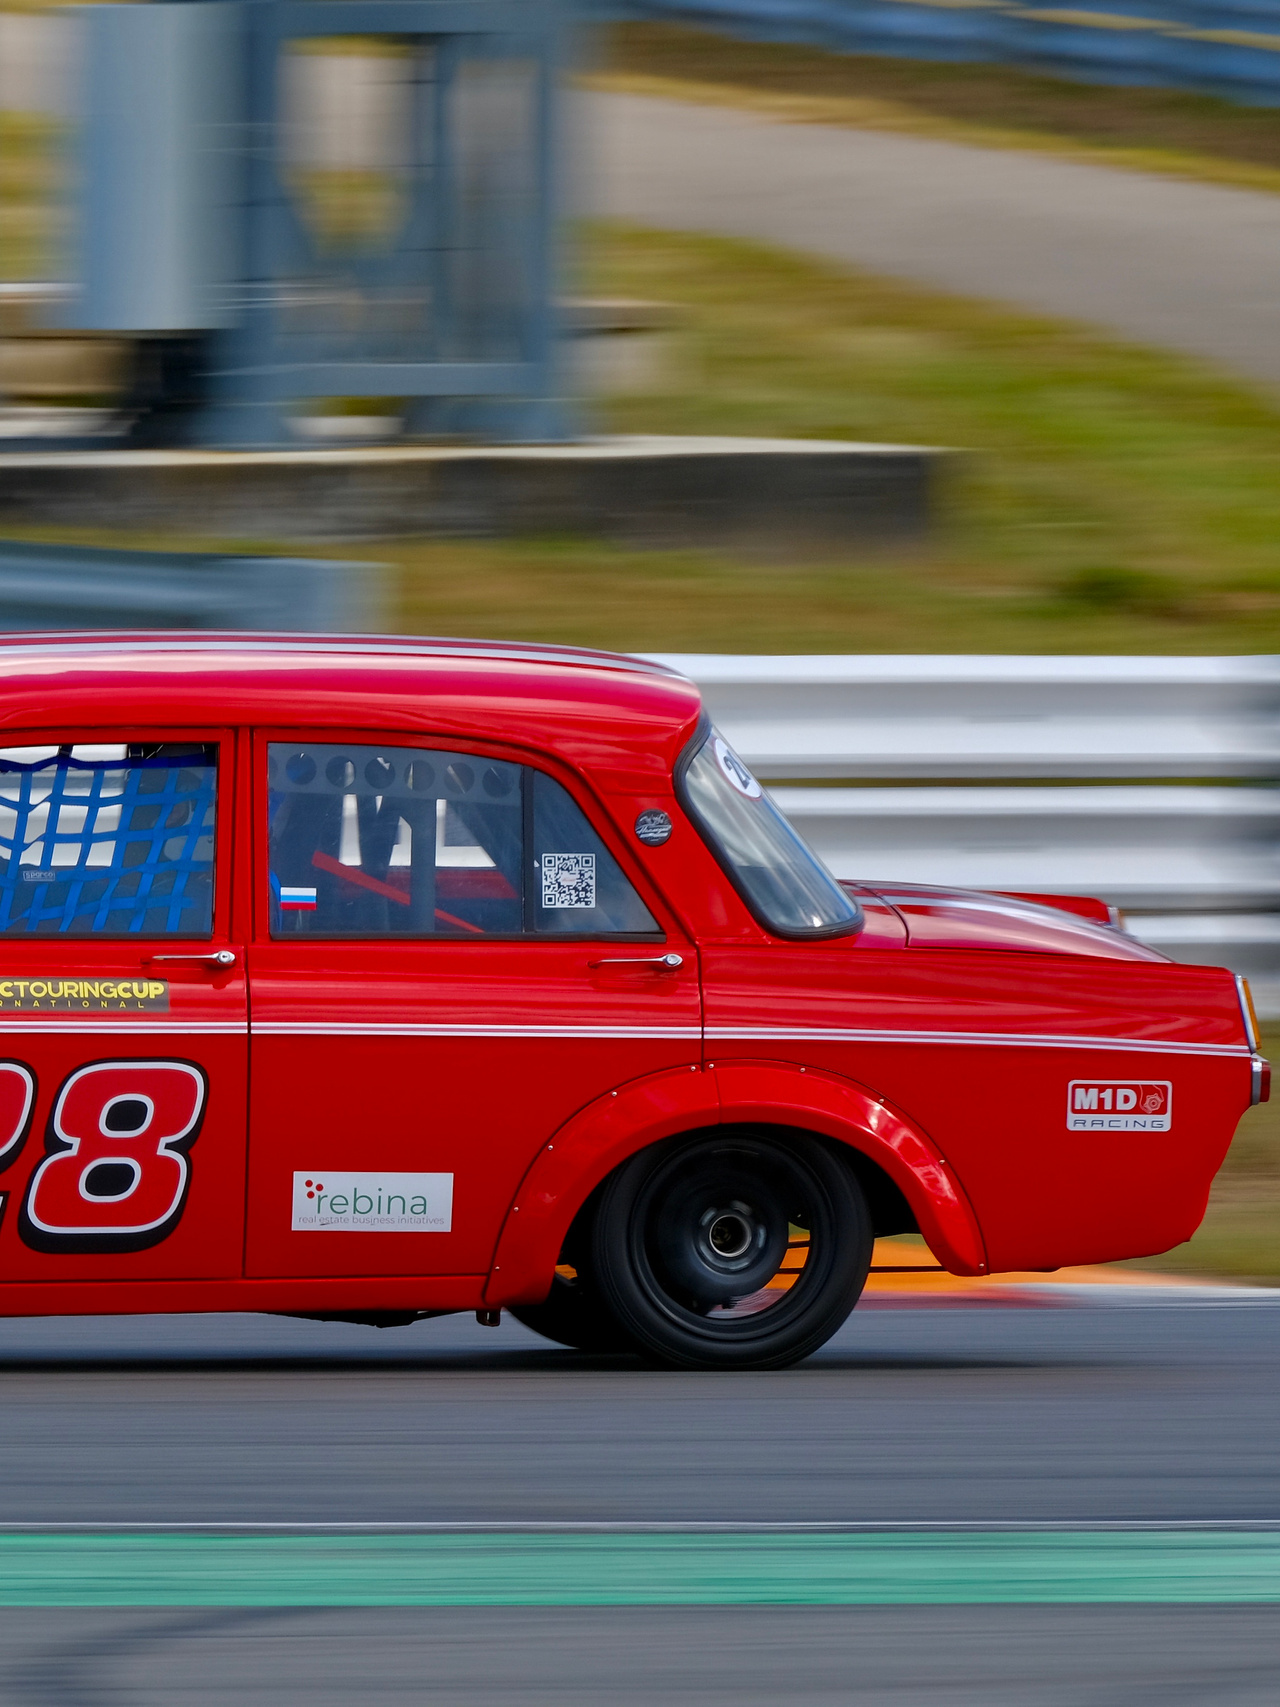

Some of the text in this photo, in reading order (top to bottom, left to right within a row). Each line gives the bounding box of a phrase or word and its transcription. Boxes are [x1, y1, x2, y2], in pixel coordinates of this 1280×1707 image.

[1074, 1088, 1138, 1110] M1D
[1073, 1119, 1165, 1128] RACING
[317, 1187, 427, 1215] rebina
[298, 1215, 445, 1225] real estate business initiatives
